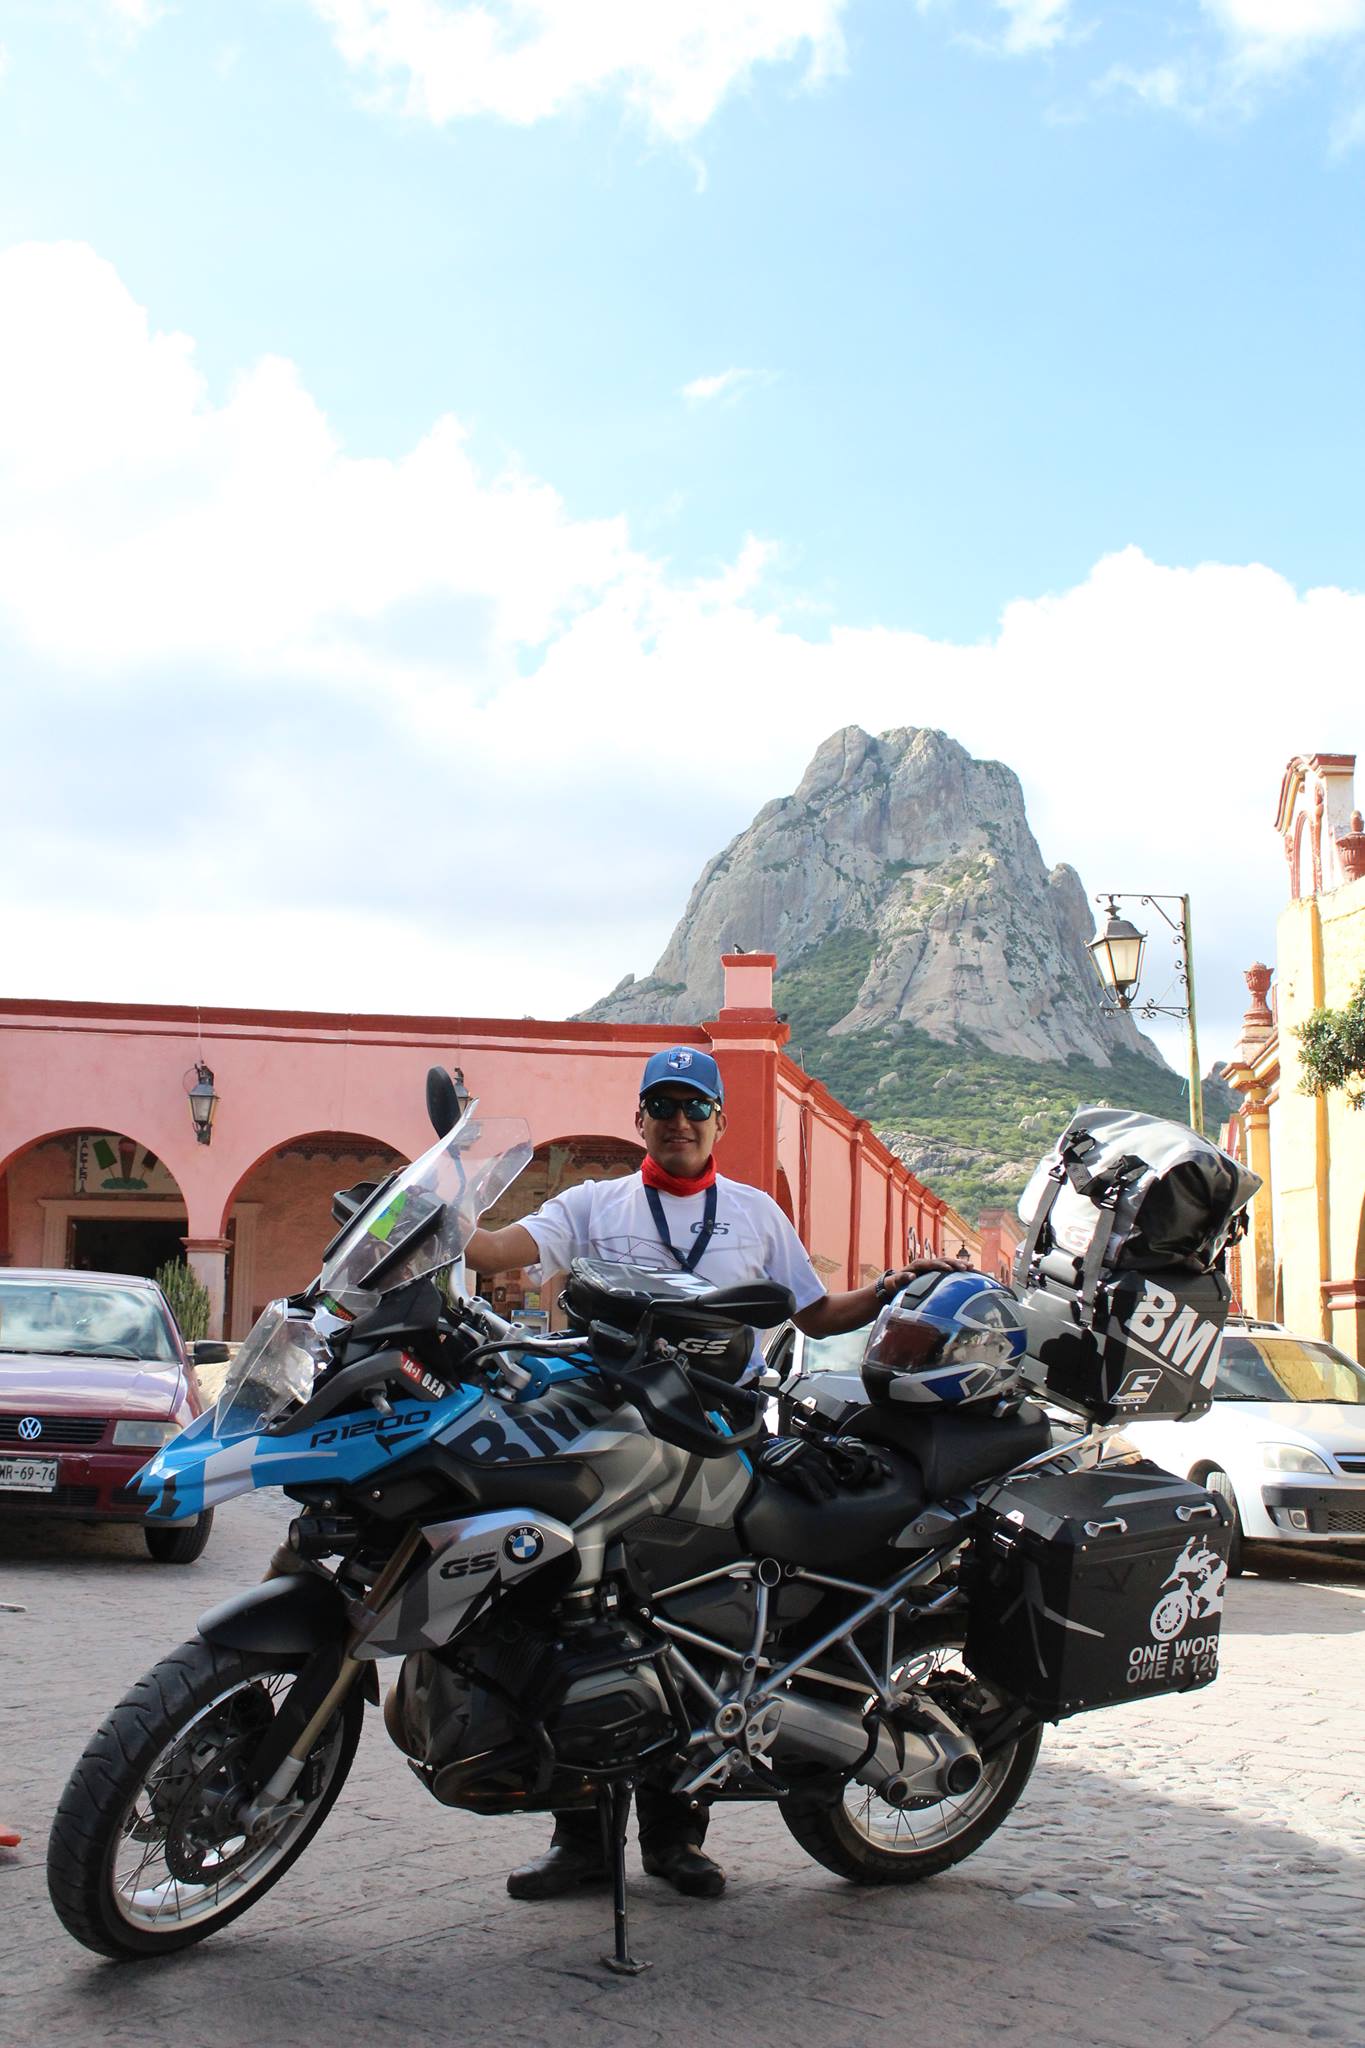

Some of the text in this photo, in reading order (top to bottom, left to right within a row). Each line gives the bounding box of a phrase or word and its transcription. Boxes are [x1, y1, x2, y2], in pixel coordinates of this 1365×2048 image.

[678, 1337, 731, 1355] GS
[309, 1410, 431, 1449] R1200
[440, 1551, 498, 1580] GS
[1129, 1642, 1170, 1666] ONE
[1171, 1657, 1185, 1676] R
